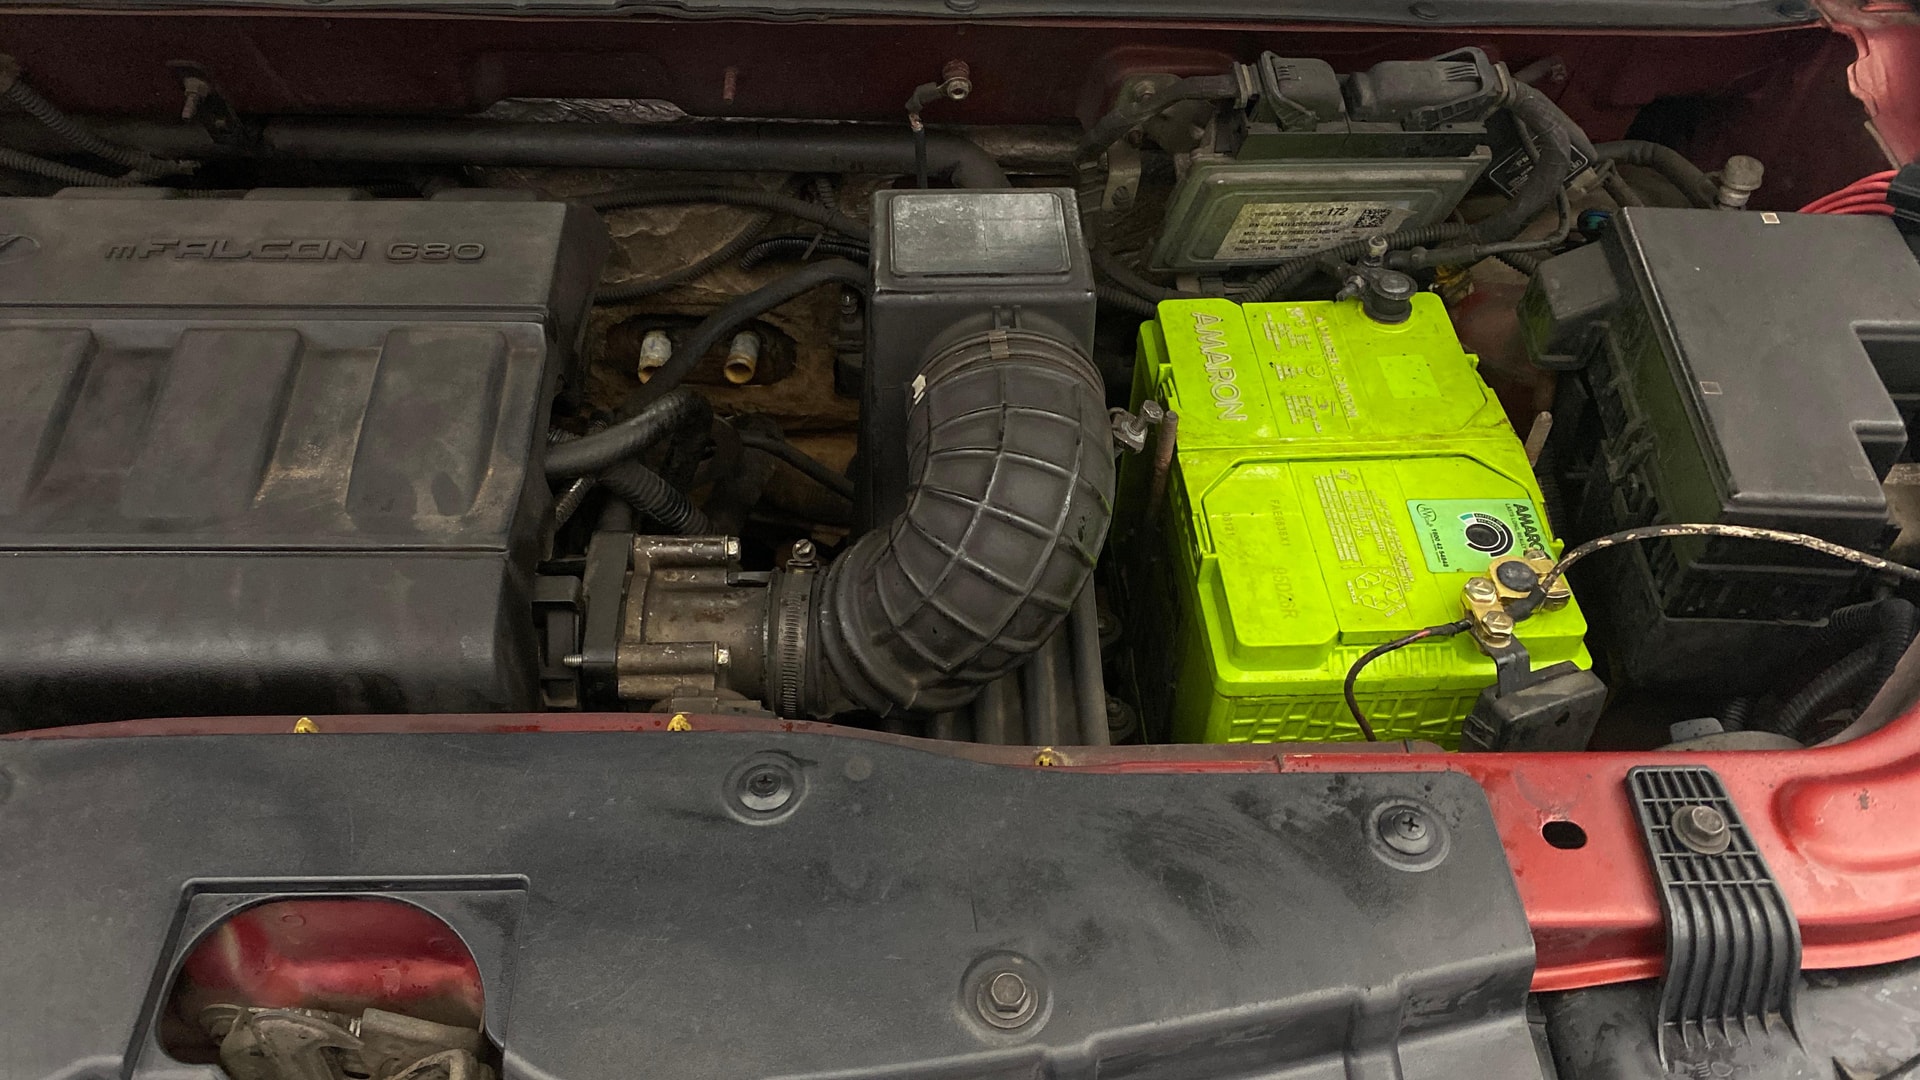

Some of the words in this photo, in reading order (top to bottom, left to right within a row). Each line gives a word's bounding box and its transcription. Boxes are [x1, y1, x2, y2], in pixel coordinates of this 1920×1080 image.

[1326, 207, 1349, 217] 172
[385, 242, 487, 263] G80
[1191, 311, 1249, 421] AMARON
[1504, 503, 1514, 517] LASTS
[1431, 528, 1441, 542] 1800
[1436, 542, 1444, 550] 42
[1513, 503, 1552, 560] AMARO
